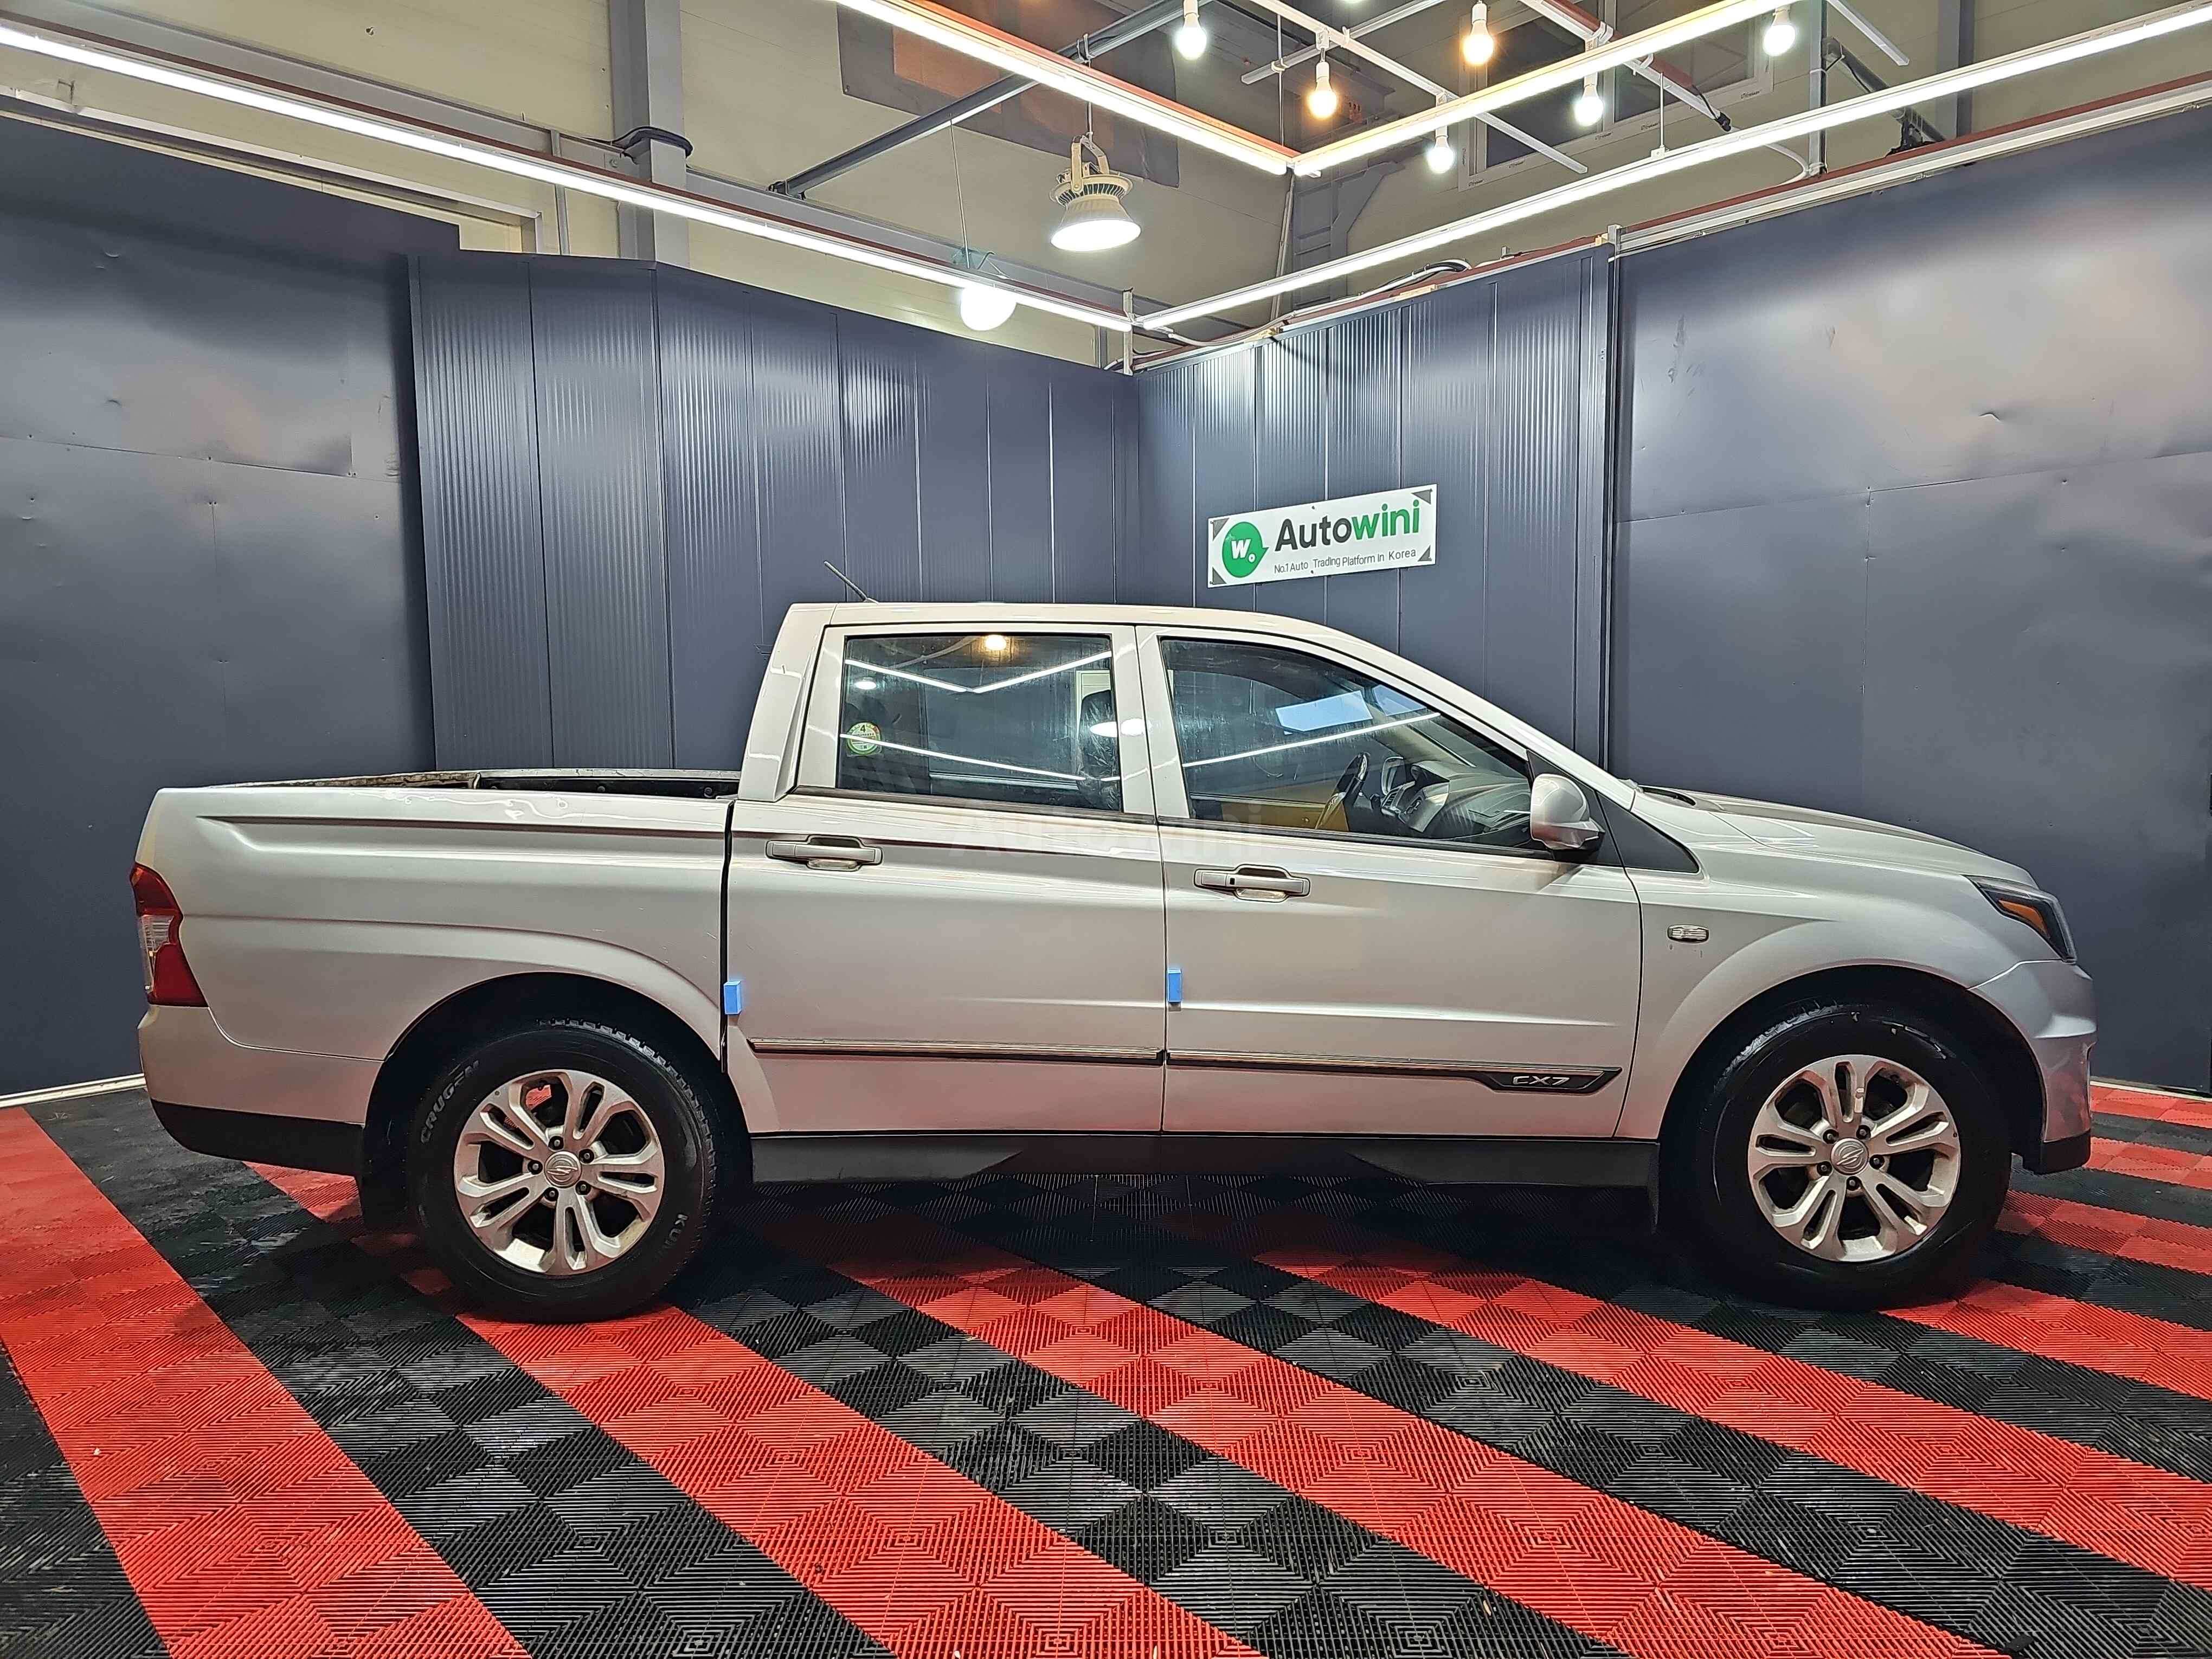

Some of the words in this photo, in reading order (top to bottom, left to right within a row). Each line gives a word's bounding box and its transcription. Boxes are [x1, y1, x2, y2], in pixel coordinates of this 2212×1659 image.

[1275, 499, 1420, 552] Autowini
[1274, 563, 1289, 574] No.1
[1290, 561, 1309, 572] Auto
[1313, 556, 1341, 568] Trading
[1342, 554, 1375, 567] Platform
[1388, 549, 1416, 561] Korea
[860, 724, 866, 732] 4
[1513, 1076, 1570, 1085] CX7
